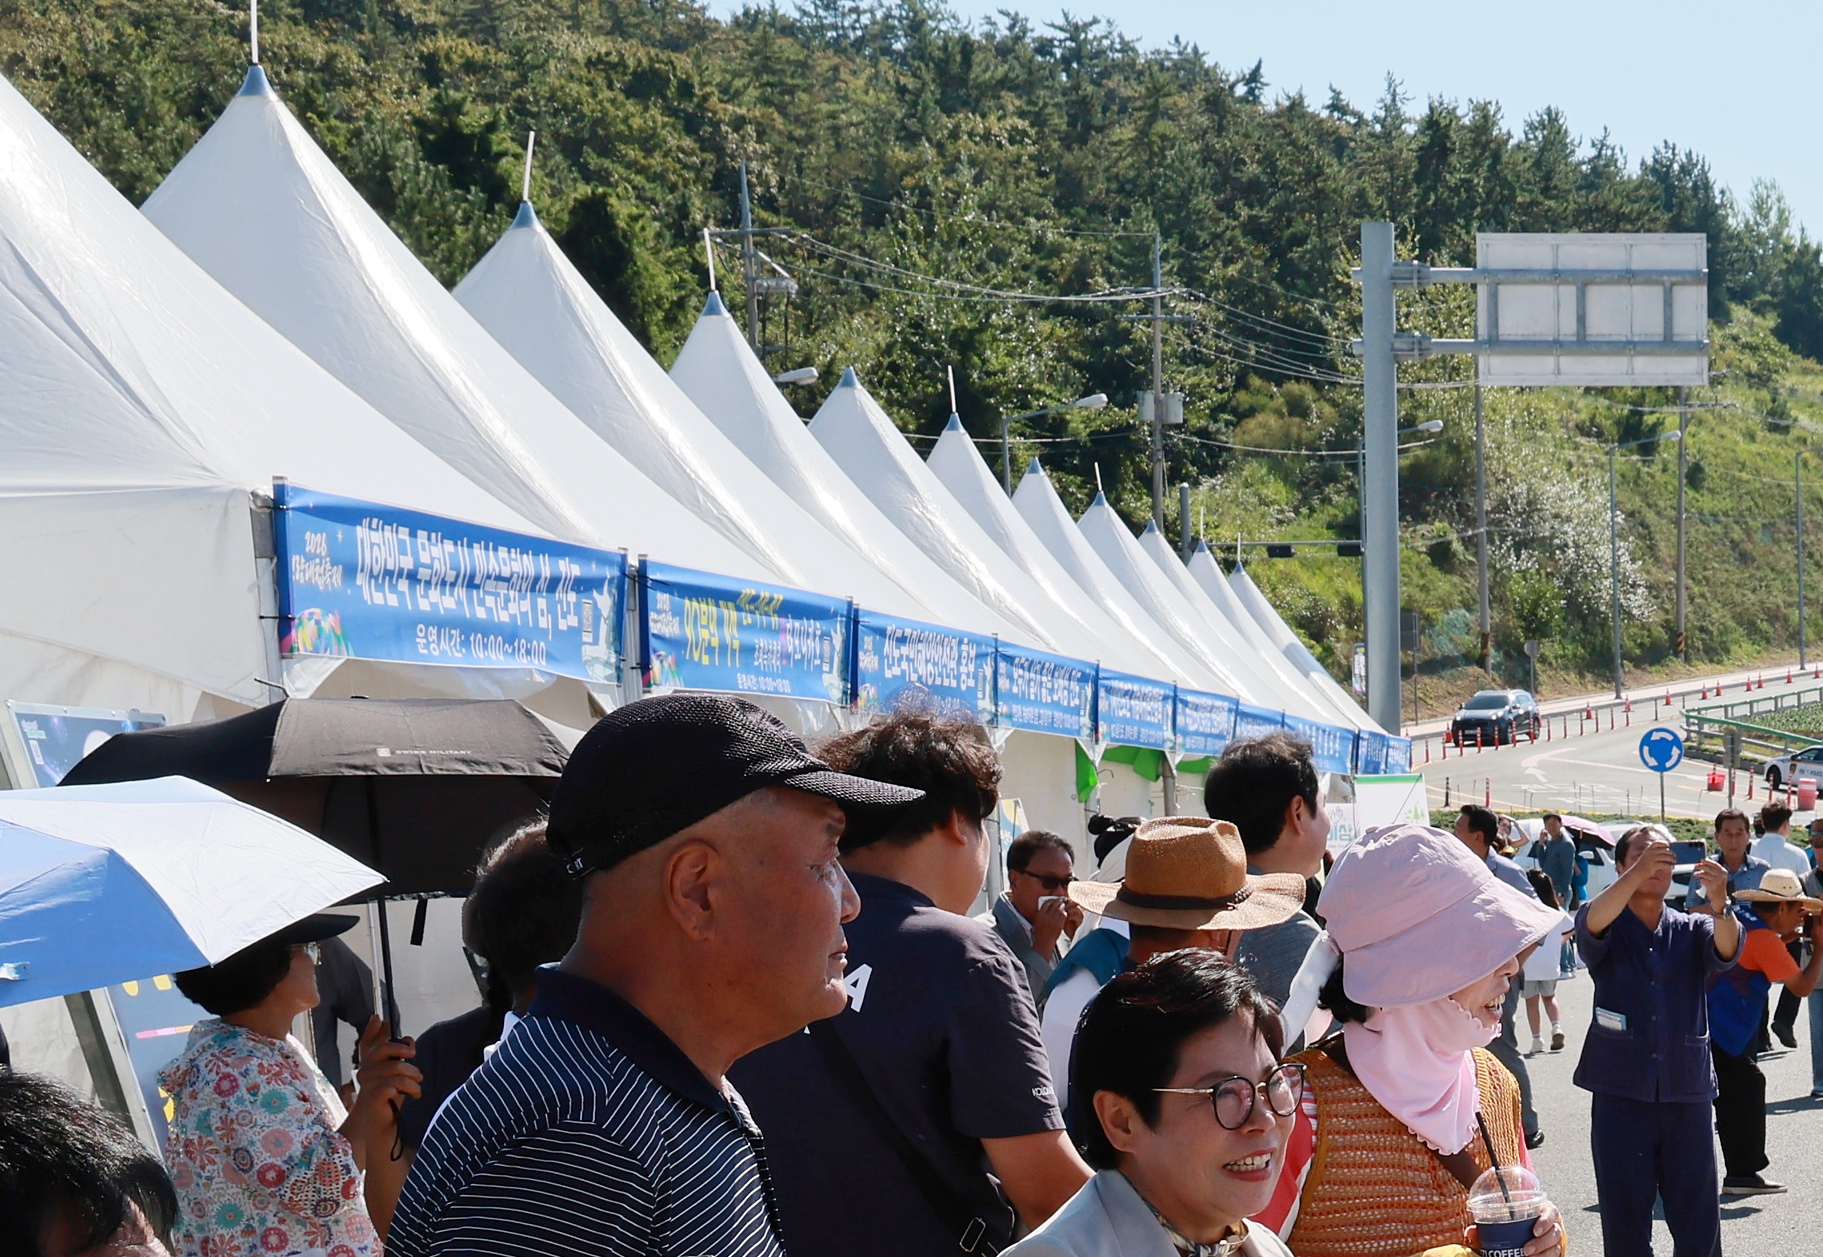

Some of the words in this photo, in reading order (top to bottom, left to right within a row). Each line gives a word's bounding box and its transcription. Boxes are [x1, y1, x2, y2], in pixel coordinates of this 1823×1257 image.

[305, 531, 327, 555] 2026
[356, 517, 414, 610] 대한민국
[416, 530, 470, 619] 문화도시
[473, 540, 533, 627] 민속문화의
[556, 557, 580, 631] 진도
[415, 623, 466, 659] 운영시간:
[470, 633, 547, 666] 10:00~18:00
[960, 637, 976, 691] 홍보
